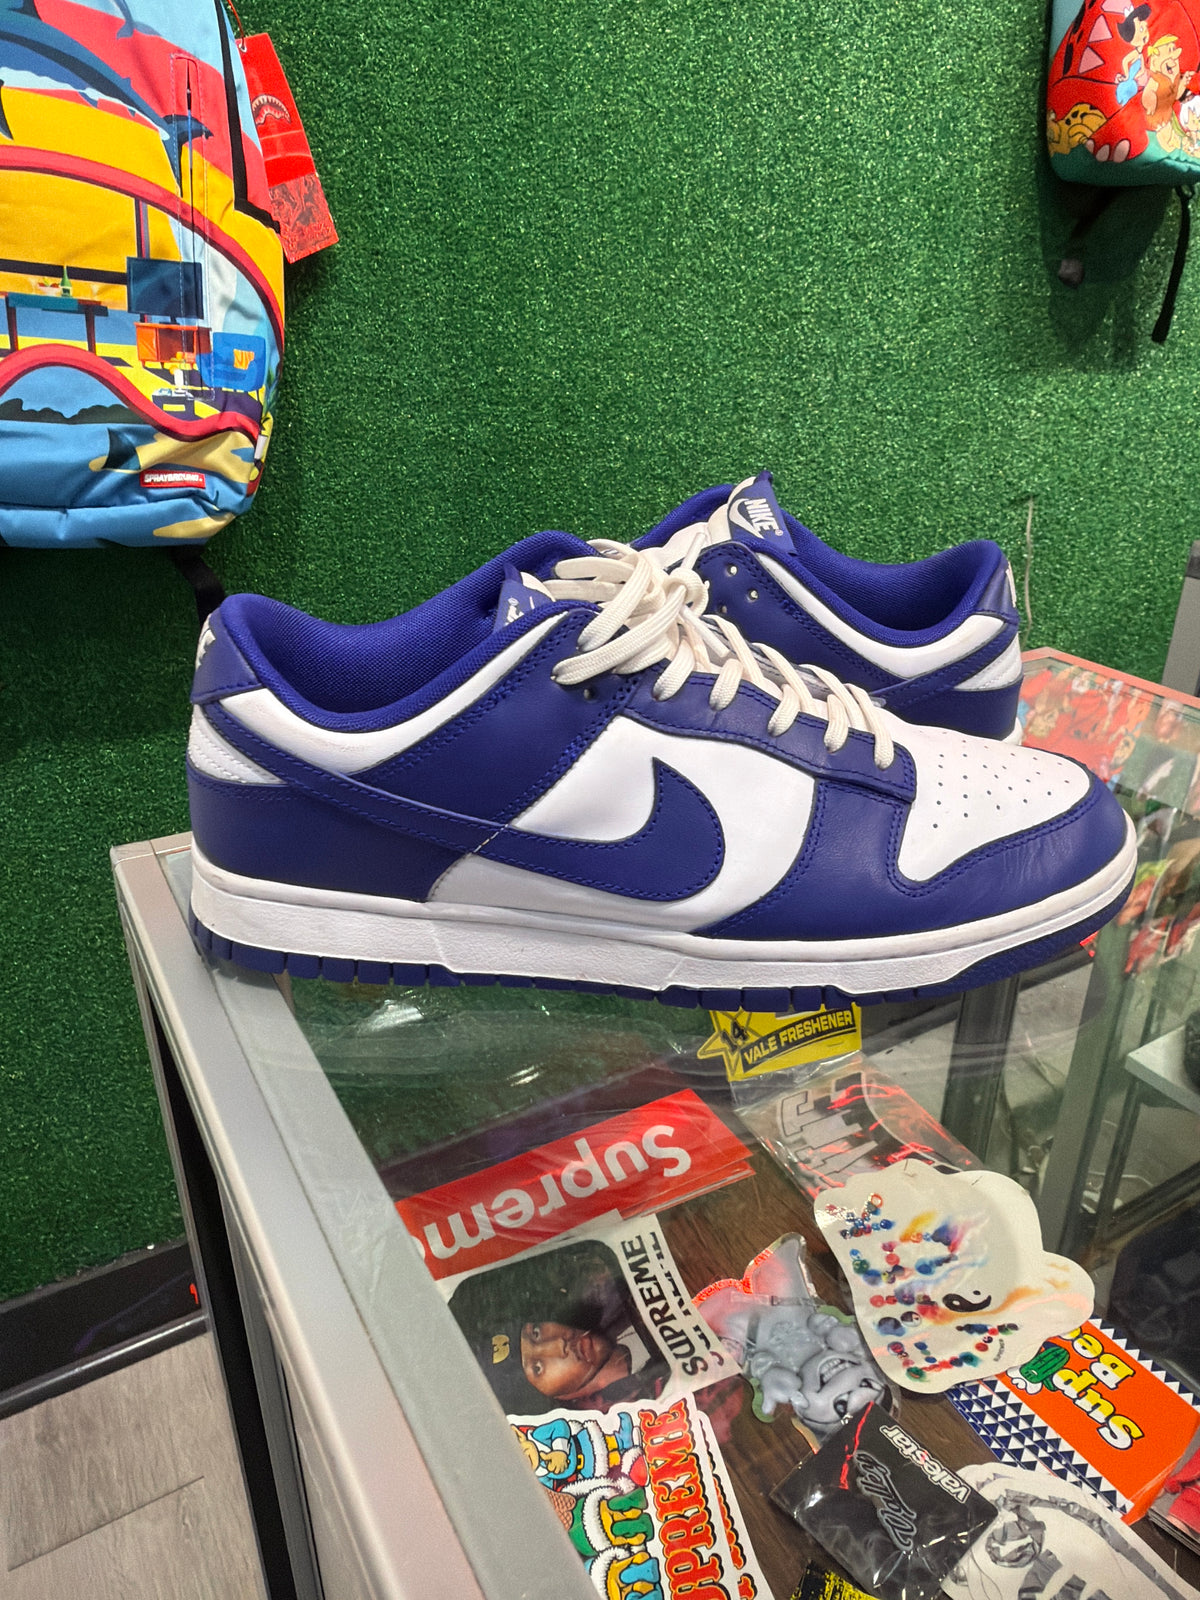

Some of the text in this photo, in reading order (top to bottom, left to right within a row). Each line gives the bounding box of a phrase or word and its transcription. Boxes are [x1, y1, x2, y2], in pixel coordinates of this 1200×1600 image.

[744, 498, 780, 531] NIKE
[743, 1010, 854, 1064] VALE FRESHENER
[418, 1124, 692, 1262] Suprem
[621, 1234, 708, 1377] SUPREME
[880, 1425, 971, 1503] valestar
